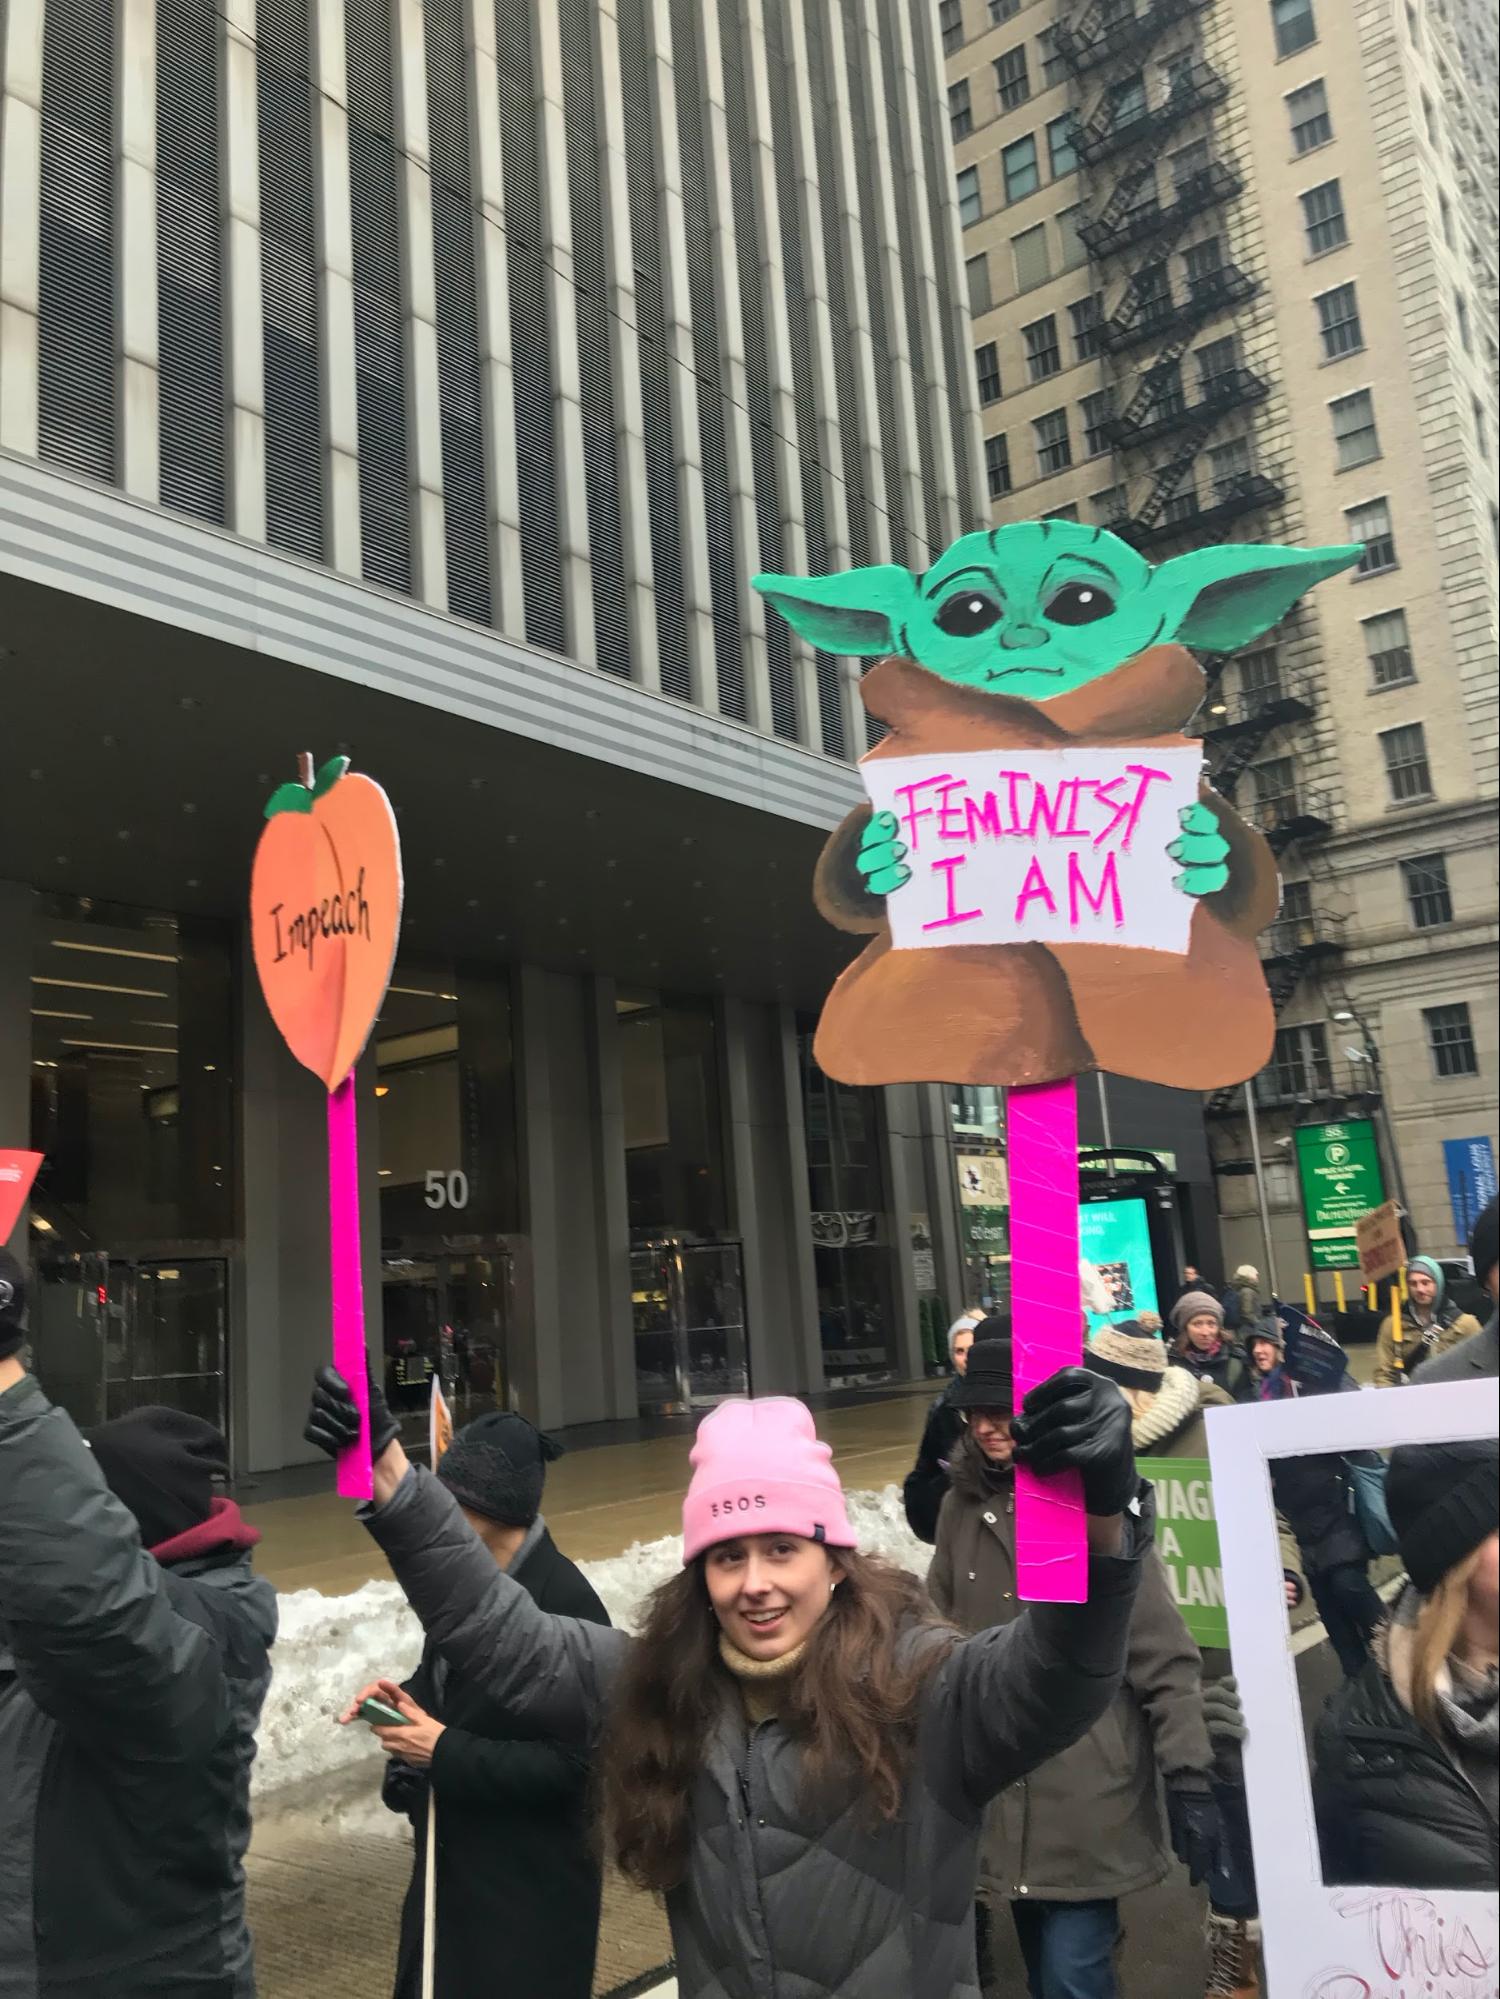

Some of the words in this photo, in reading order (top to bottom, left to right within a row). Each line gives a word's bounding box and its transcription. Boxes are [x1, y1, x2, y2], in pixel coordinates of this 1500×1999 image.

[894, 765, 1172, 851] FEMINIST
[270, 866, 371, 971] Impeach
[922, 854, 984, 931] I
[1014, 850, 1126, 931] AM
[424, 1170, 469, 1209] 50
[1161, 1526, 1184, 1558] A
[1329, 1888, 1495, 1981] This
